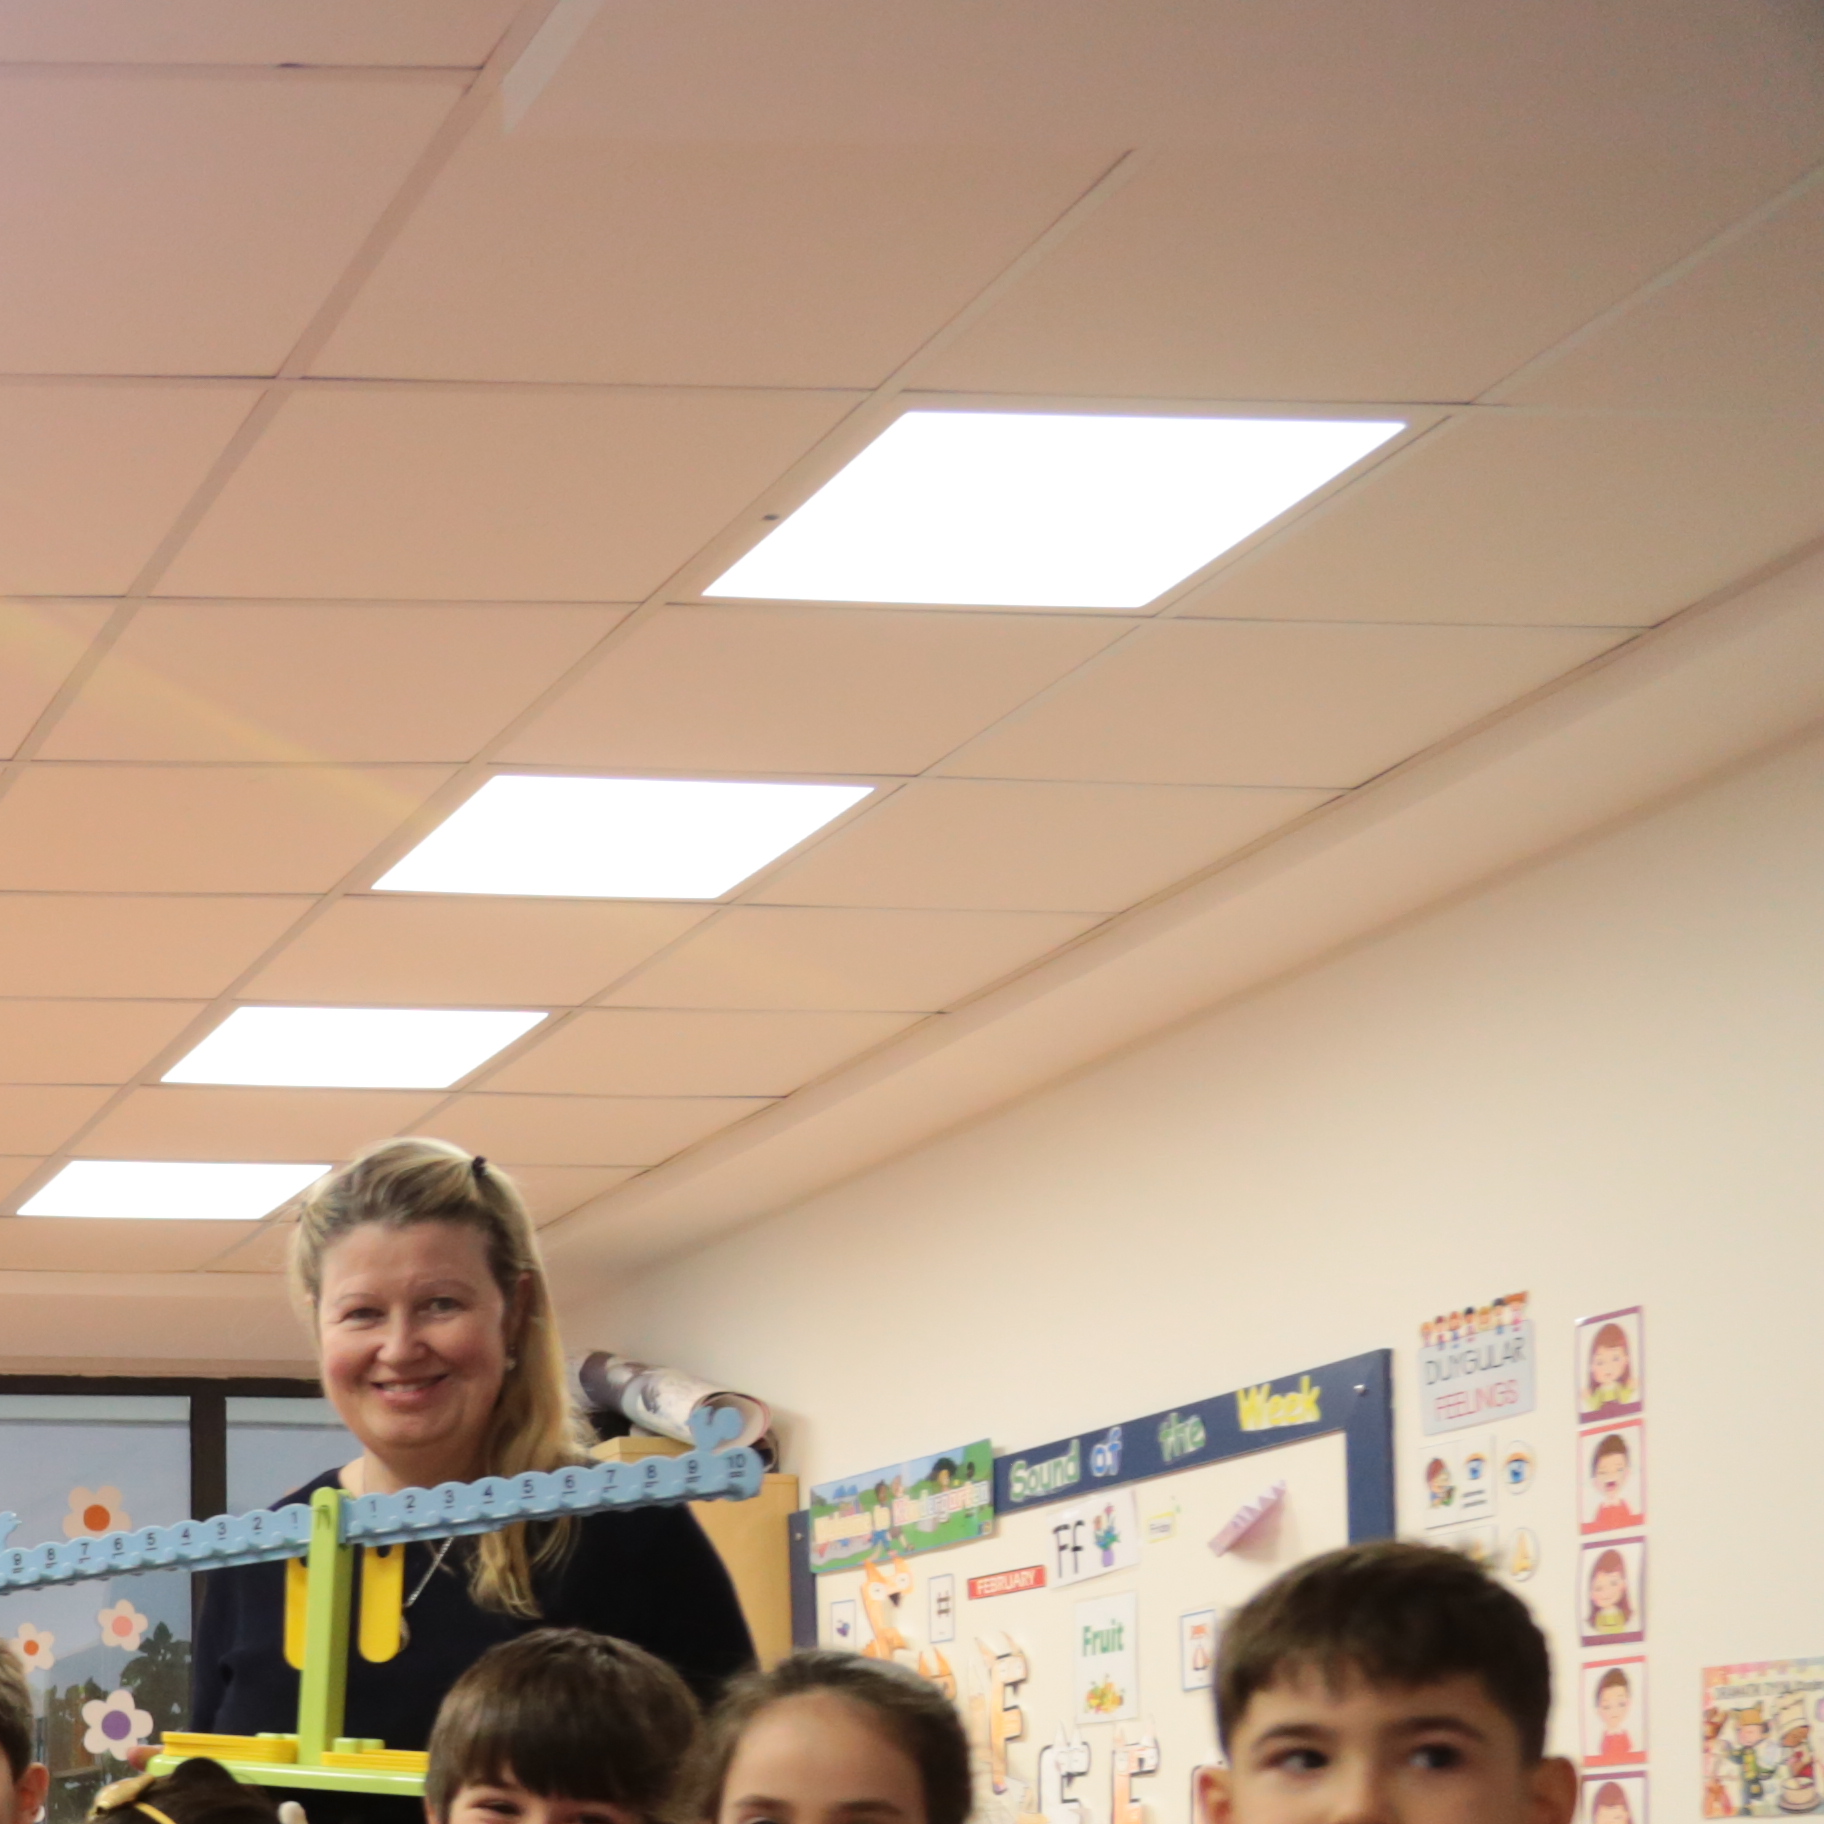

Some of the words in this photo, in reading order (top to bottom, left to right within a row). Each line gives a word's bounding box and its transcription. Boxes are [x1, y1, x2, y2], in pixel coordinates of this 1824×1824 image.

[1424, 1336, 1527, 1386] DUYGULAR
[1434, 1378, 1519, 1422] FEELINGS
[1009, 1437, 1081, 1503] Sound
[1090, 1426, 1123, 1478] of
[1158, 1411, 1206, 1463] the
[1236, 1374, 1322, 1432] Week
[1052, 1519, 1086, 1579] Ff
[975, 1567, 1037, 1596] FEBRUARY
[1081, 1617, 1125, 1658] Fruit
